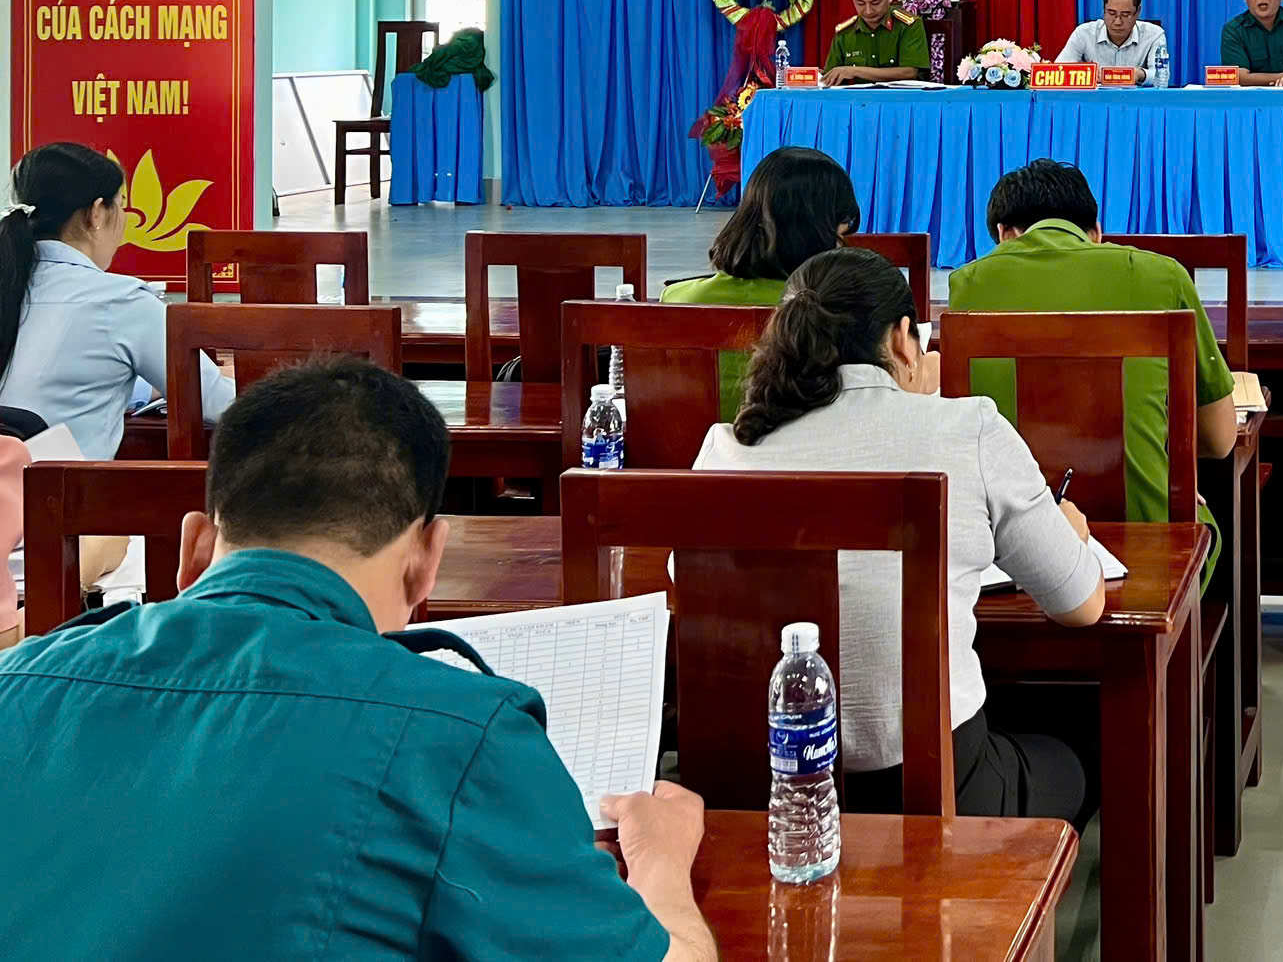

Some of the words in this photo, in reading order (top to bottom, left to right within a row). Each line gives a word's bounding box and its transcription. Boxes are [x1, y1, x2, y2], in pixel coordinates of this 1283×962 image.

[158, 5, 227, 47] MẠNG
[1035, 66, 1065, 86] CHỦ
[1069, 67, 1092, 86] TRÌ
[72, 73, 120, 122] VIỆT
[128, 81, 188, 114] NAM!
